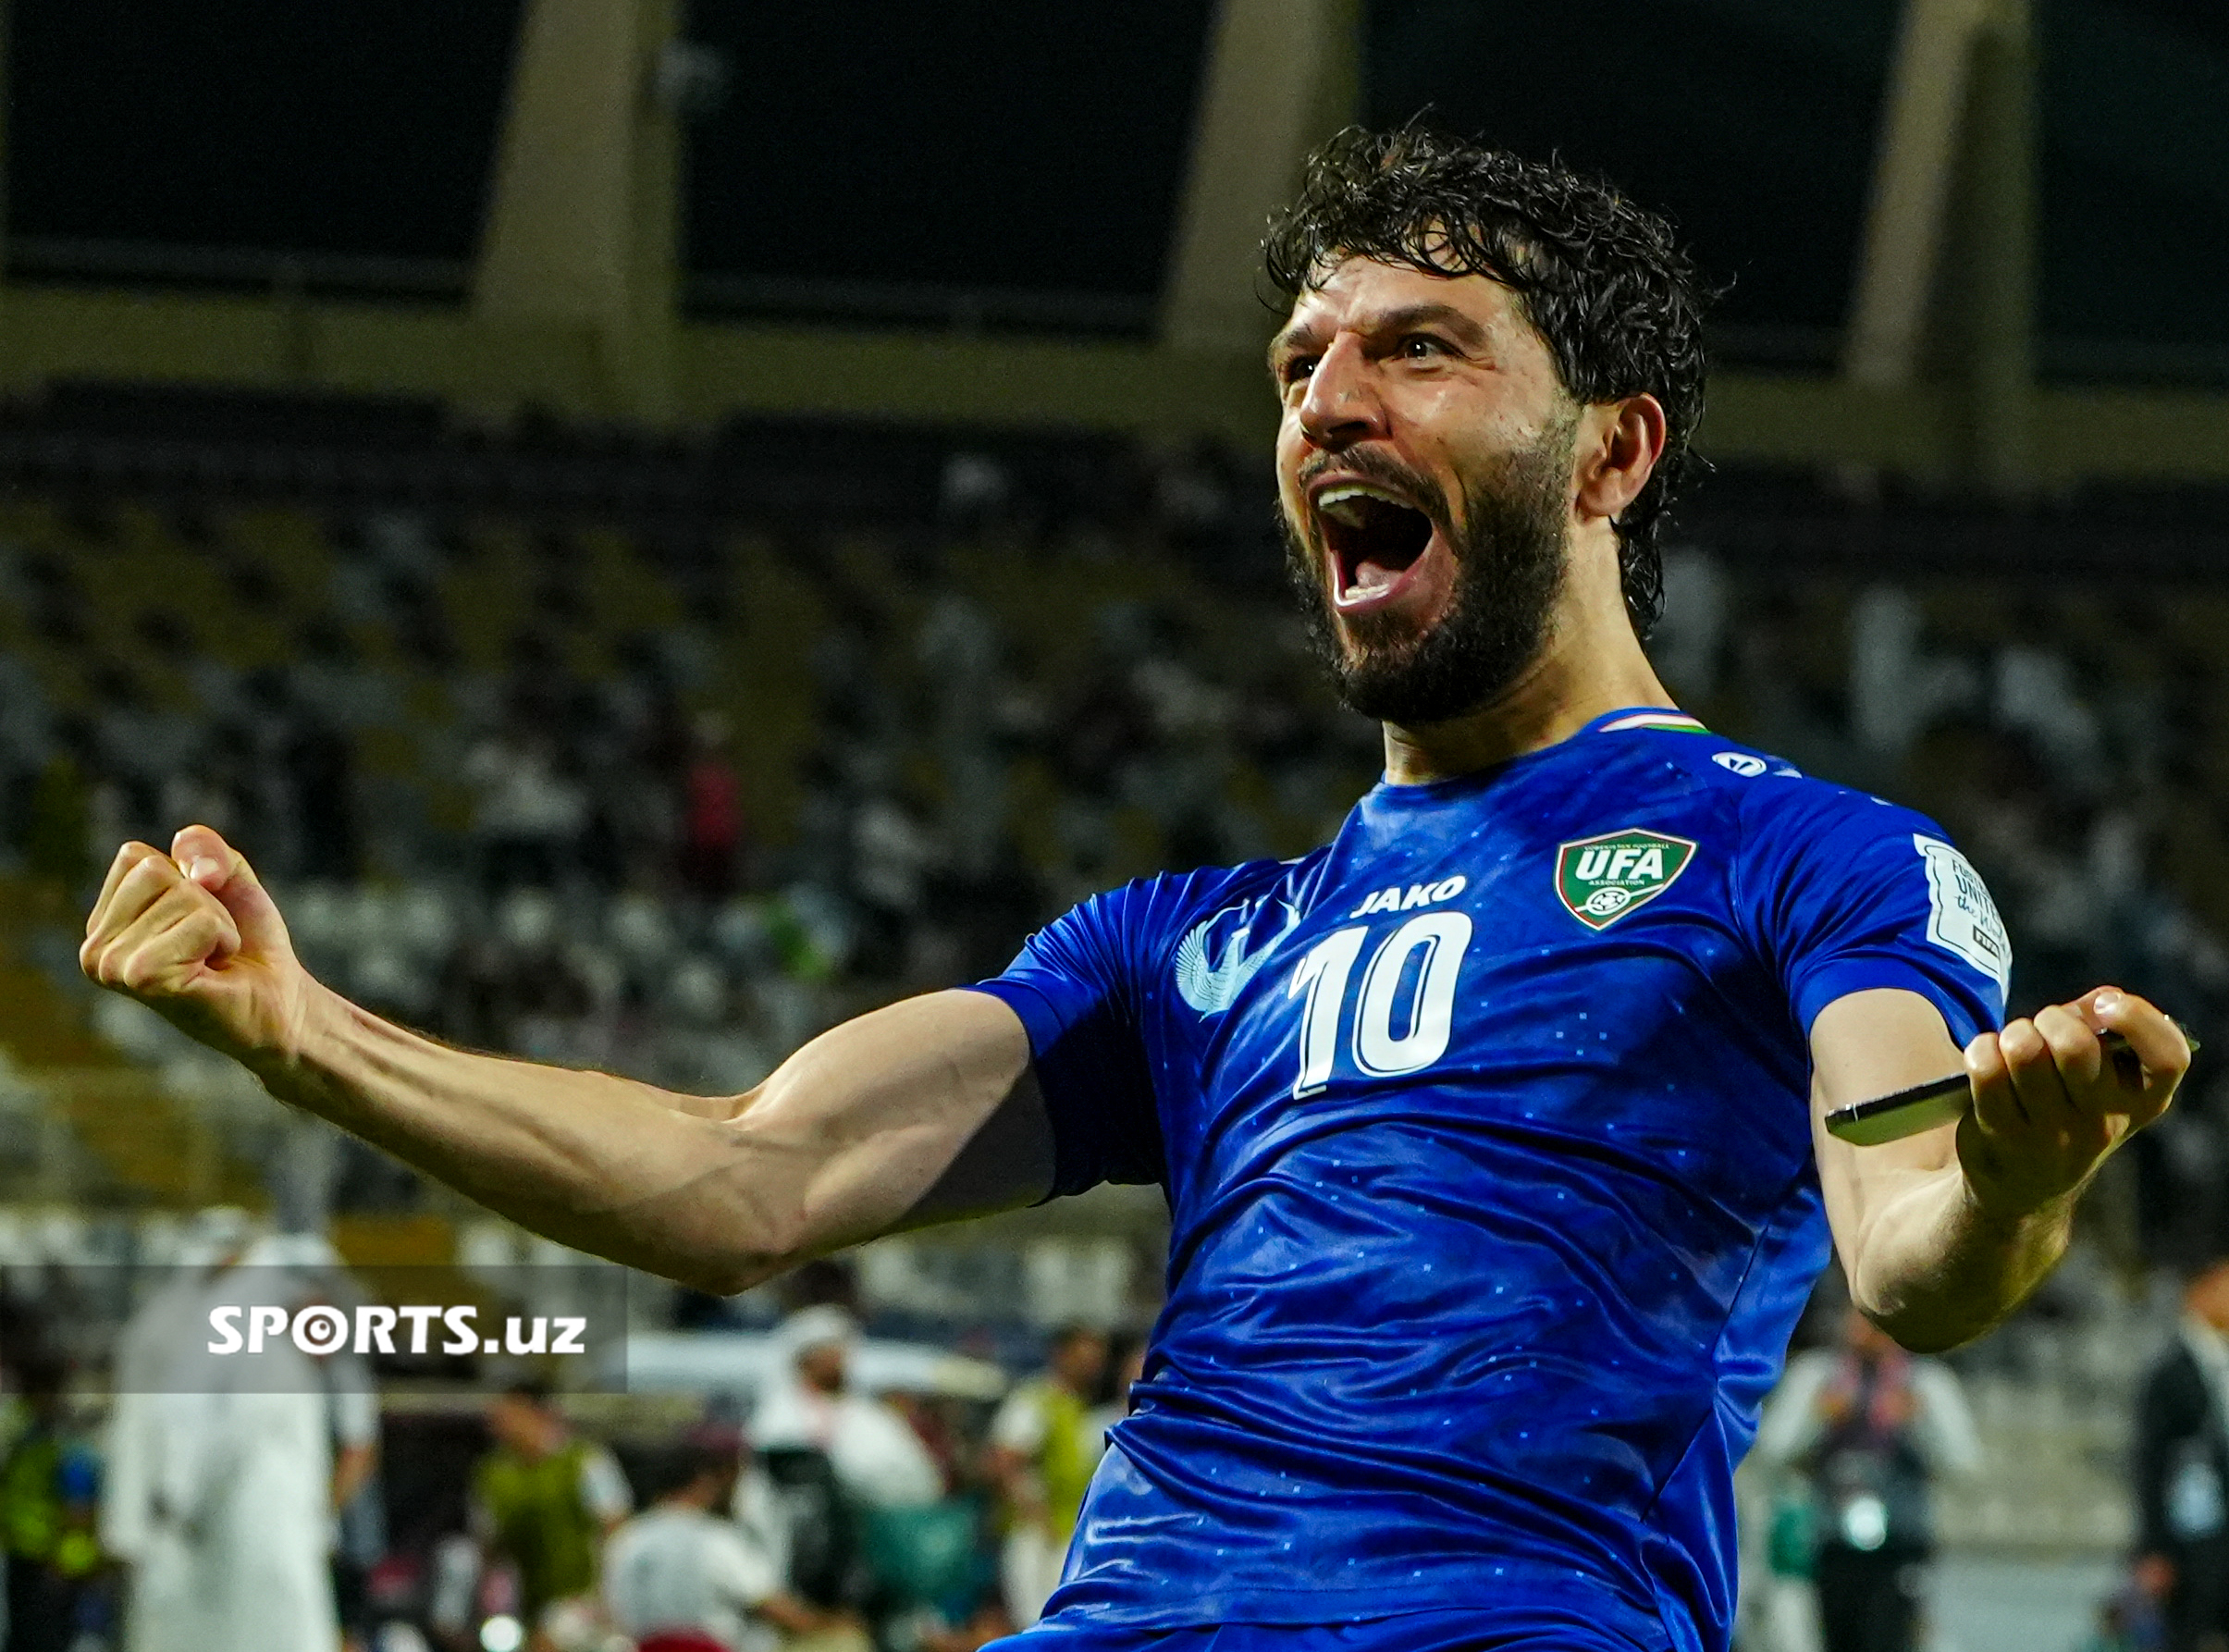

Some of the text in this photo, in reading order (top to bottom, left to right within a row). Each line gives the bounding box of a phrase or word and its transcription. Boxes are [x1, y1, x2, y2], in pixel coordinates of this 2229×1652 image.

[1575, 849, 1663, 880] UFA
[1349, 876, 1467, 918] JAKO
[1287, 911, 1472, 1100] 10
